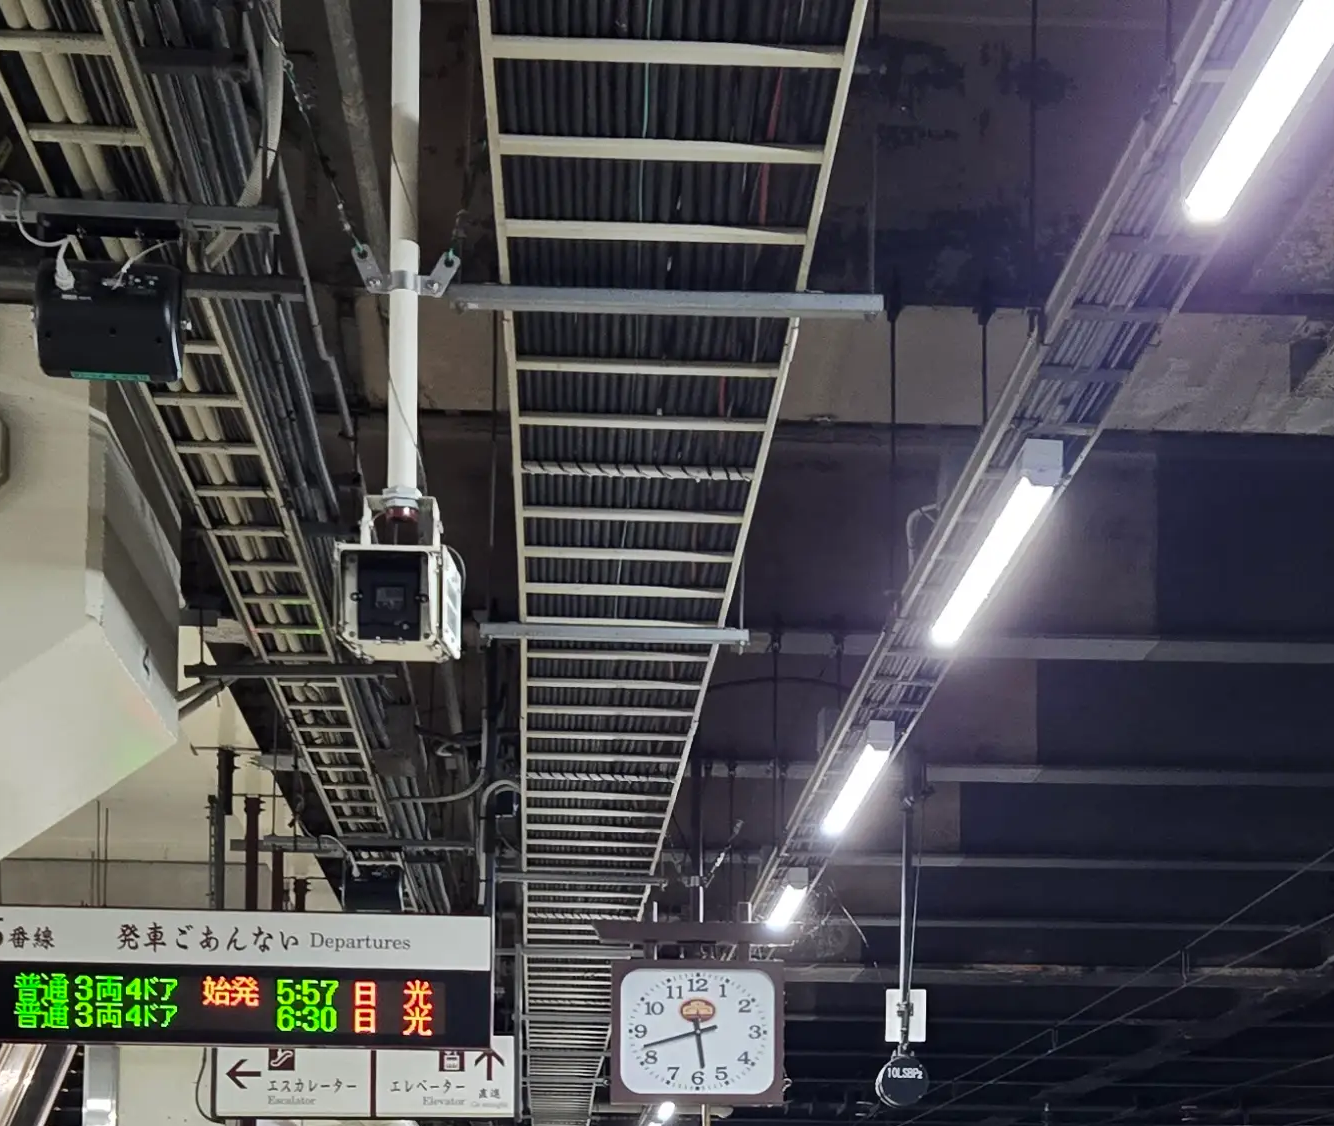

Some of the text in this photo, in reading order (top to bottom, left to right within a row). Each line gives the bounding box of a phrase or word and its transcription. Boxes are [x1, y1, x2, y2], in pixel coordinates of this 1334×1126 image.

[116, 921, 299, 953] 発車ごあんない
[309, 931, 412, 952] Departures
[202, 975, 259, 1007] 始発
[276, 978, 340, 1006] 5:57
[667, 985, 684, 999] 11
[687, 978, 709, 993] 12
[719, 984, 728, 998] 1
[644, 1001, 665, 1016] 10
[738, 999, 752, 1013] 2
[276, 1006, 338, 1033] 6:30
[634, 1024, 648, 1039] 9
[748, 1025, 762, 1039] 3
[644, 1050, 658, 1065] 8
[737, 1051, 751, 1065] 4
[667, 1066, 680, 1081] 7
[691, 1070, 705, 1086] 6
[715, 1066, 728, 1081] 5
[267, 1077, 357, 1093] エスカレーター
[390, 1078, 466, 1094] エレベーター
